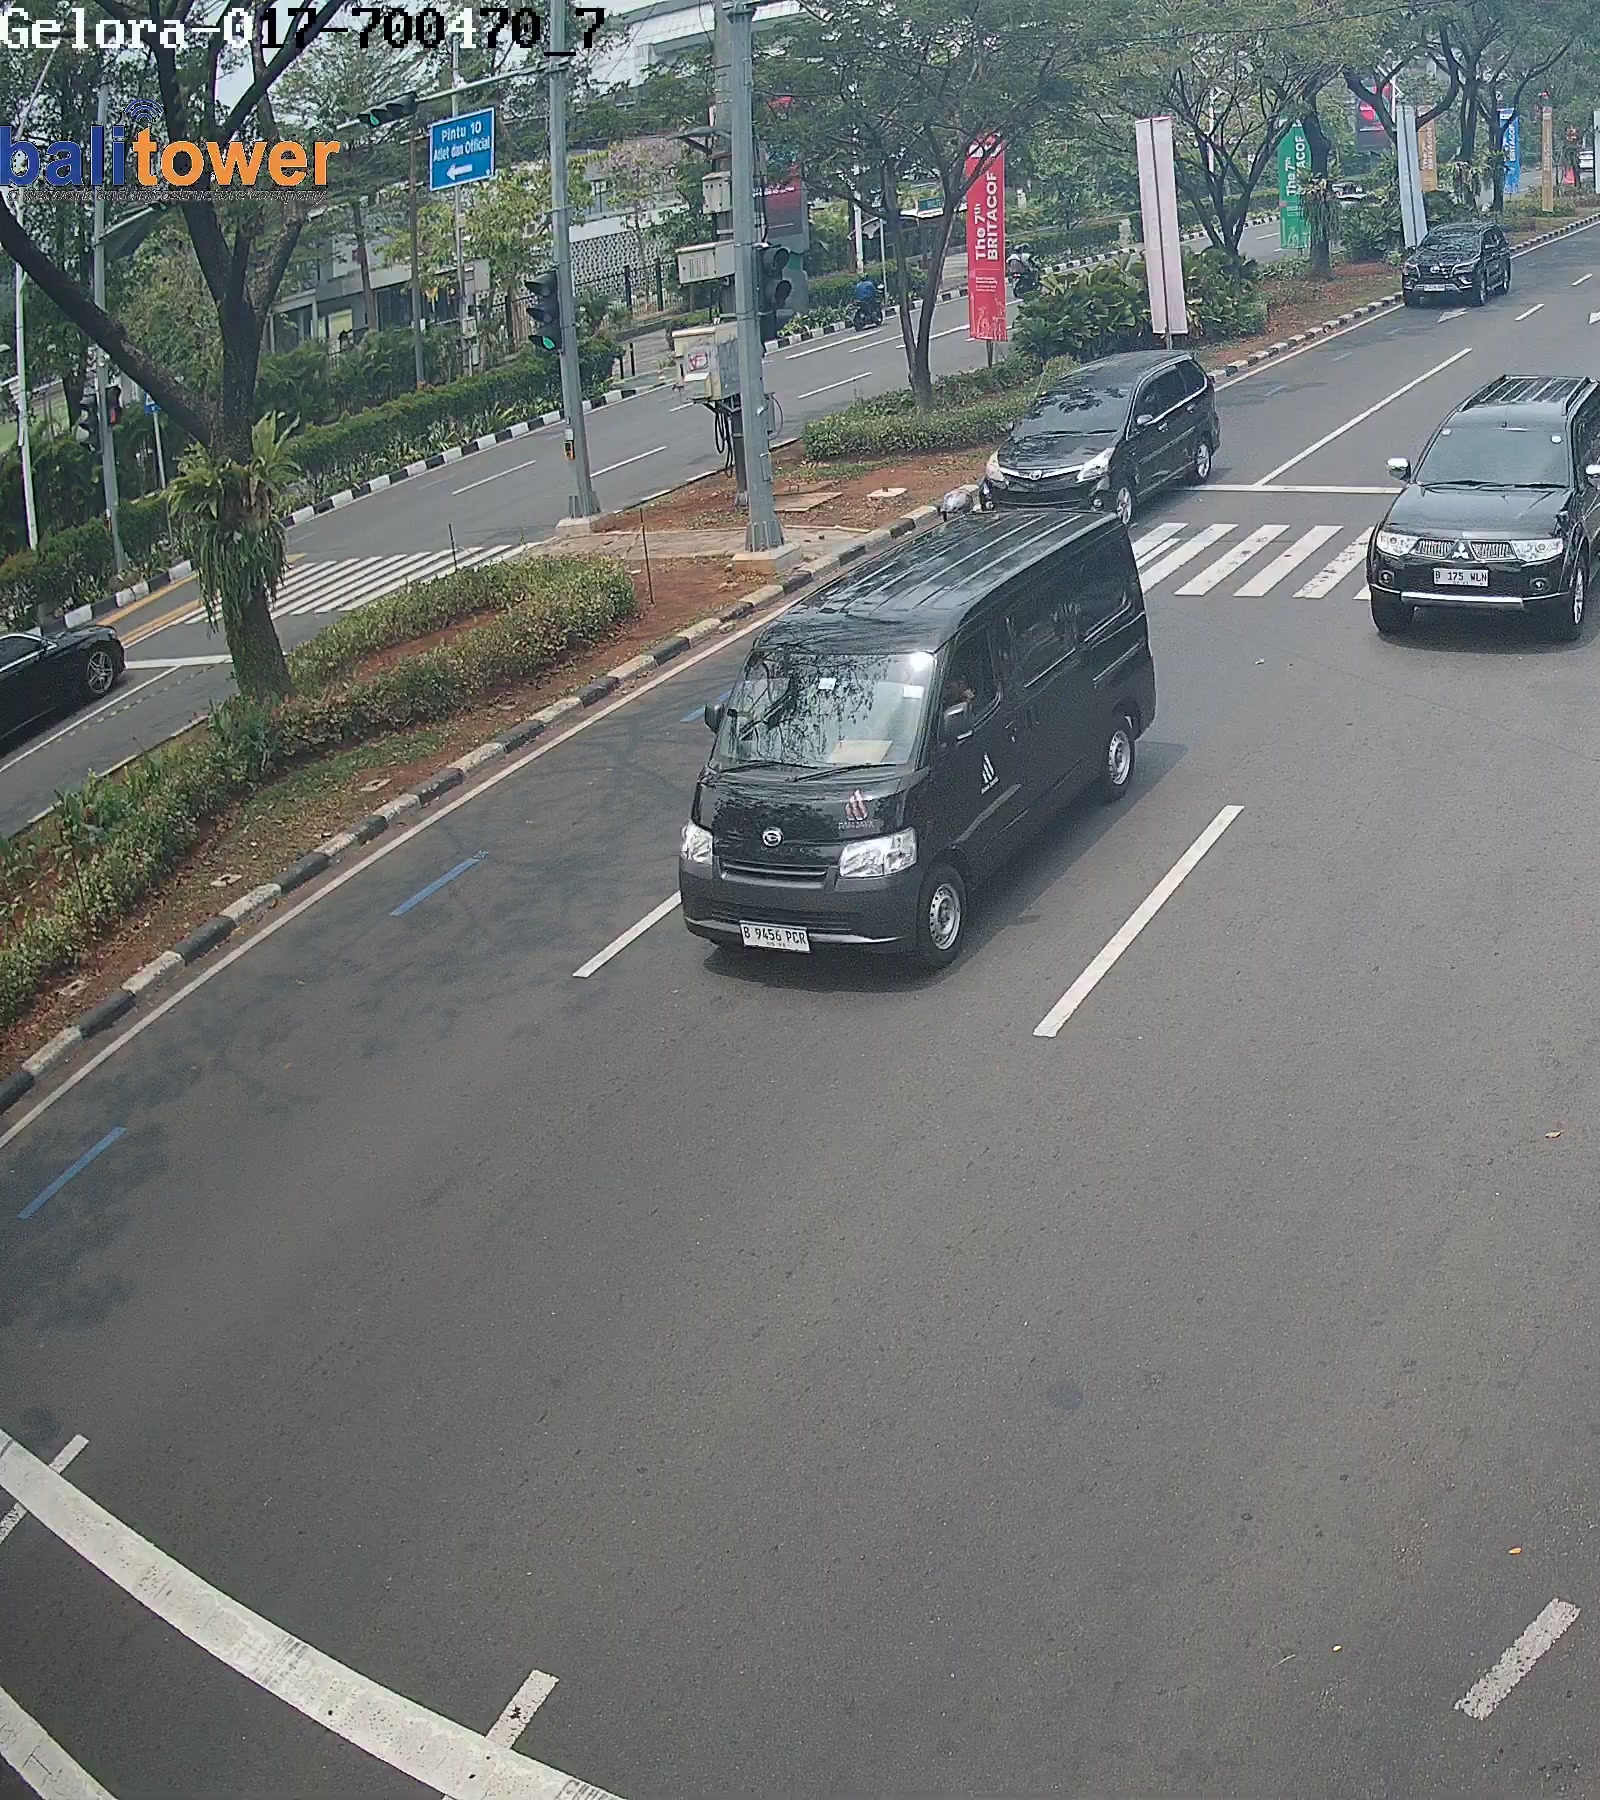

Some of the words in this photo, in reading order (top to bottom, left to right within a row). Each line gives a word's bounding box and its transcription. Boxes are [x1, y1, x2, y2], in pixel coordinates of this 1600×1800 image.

[441, 125, 467, 143] Pintu
[470, 120, 483, 135] 10
[464, 135, 491, 154] Official
[1284, 172, 1296, 197] The
[986, 171, 998, 261] BRITACOF
[974, 228, 987, 261] The
[1447, 571, 1464, 581] 175
[743, 926, 751, 939] B
[784, 930, 807, 945] PCR
